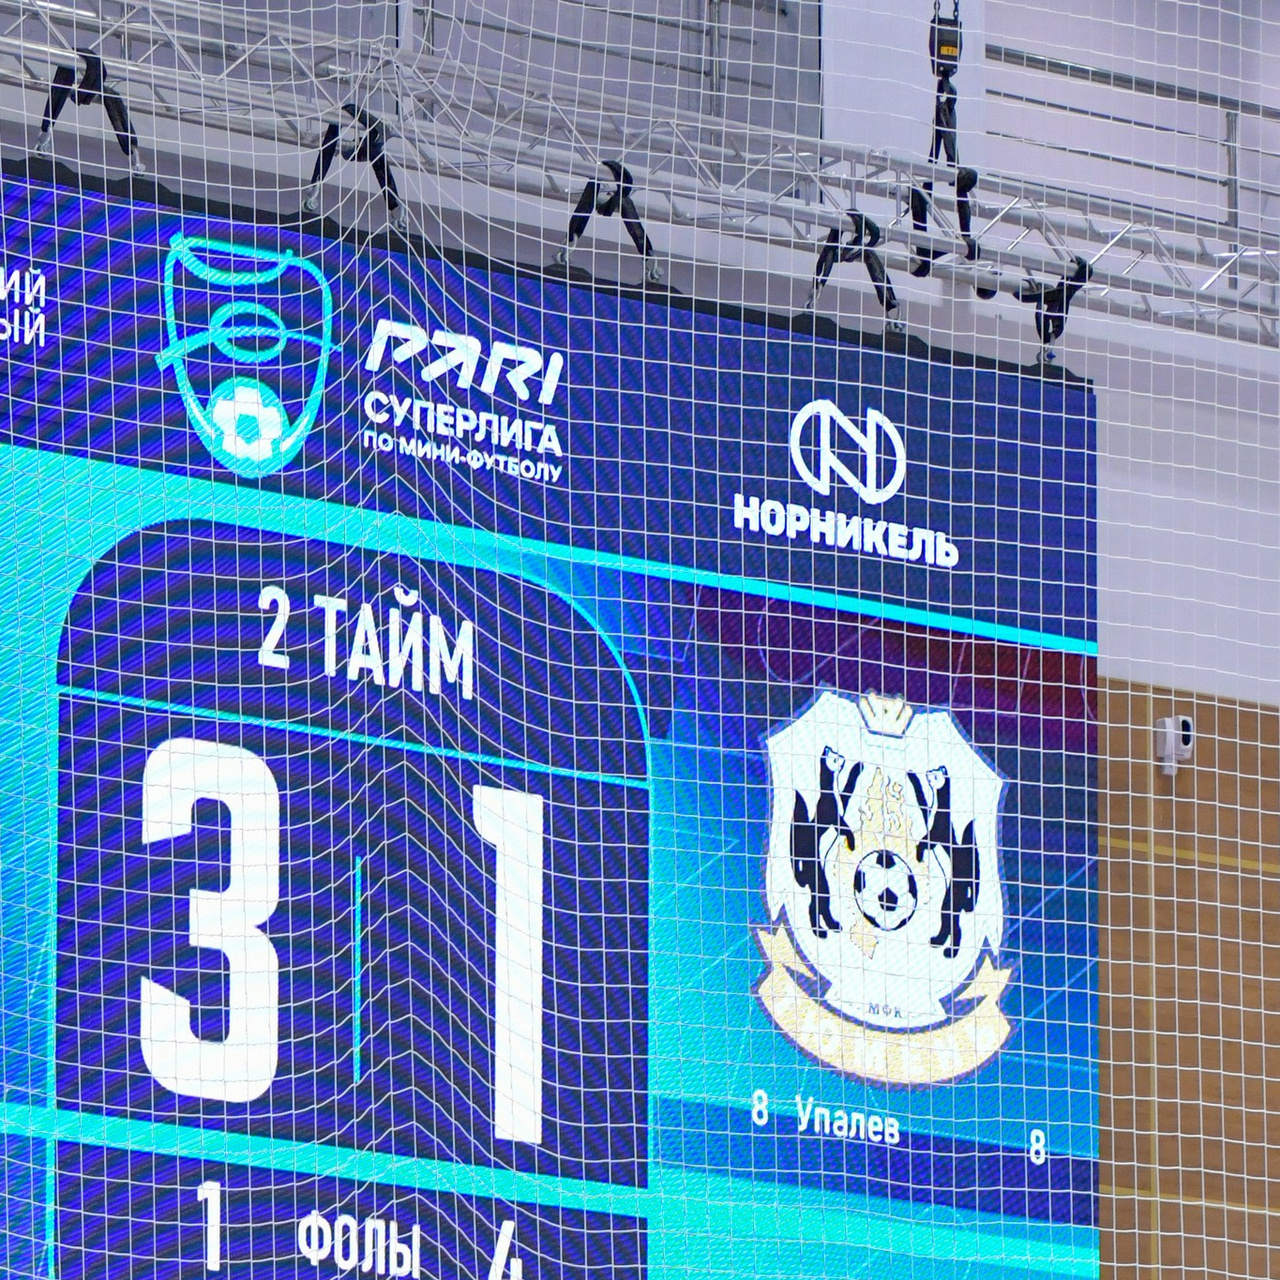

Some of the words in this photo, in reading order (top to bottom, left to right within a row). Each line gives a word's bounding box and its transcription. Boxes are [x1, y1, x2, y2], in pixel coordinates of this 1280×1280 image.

[364, 320, 565, 406] PARI
[364, 390, 563, 458] СУПЕРЛИГА
[364, 429, 394, 452] ПО
[399, 435, 563, 483] МИНИ-ФУТБОЛУ
[733, 494, 960, 568] НОРНИКЕЛЬ
[258, 585, 291, 669] 2
[314, 586, 474, 700] ТАЙМ
[140, 737, 280, 1103] 3
[473, 784, 543, 1145] 1
[751, 1089, 769, 1127] 8
[795, 1093, 901, 1145] Упалев
[1029, 1129, 1046, 1165] 8
[197, 1181, 221, 1271] 1
[298, 1210, 422, 1280] ФОЛЫ
